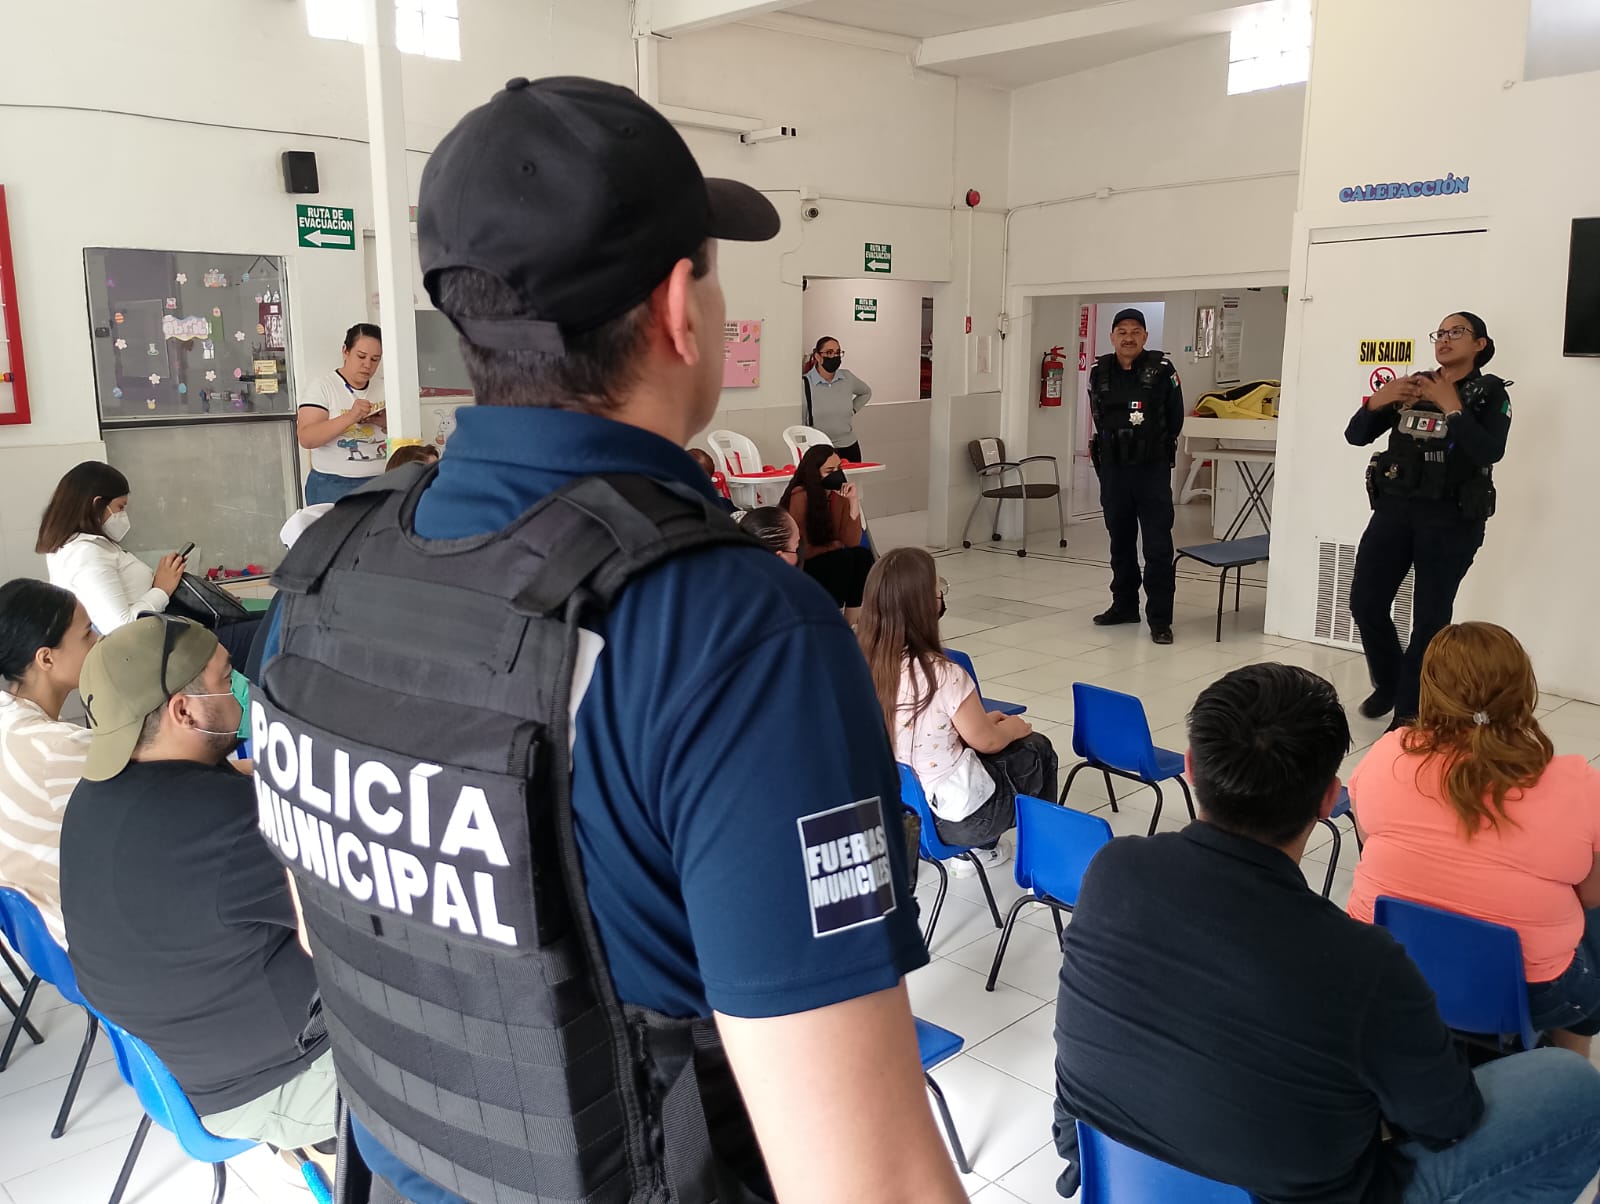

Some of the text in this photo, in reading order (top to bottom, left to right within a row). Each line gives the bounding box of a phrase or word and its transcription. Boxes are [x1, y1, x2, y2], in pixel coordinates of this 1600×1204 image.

[1339, 172, 1470, 203] CALEFACCIÓN
[307, 207, 344, 220] RUTA DE
[870, 244, 887, 253] RUTA DE
[1360, 341, 1412, 362] SIN SALIDA
[251, 700, 511, 867] POLICÍA
[254, 769, 518, 947] MUNICIPAL
